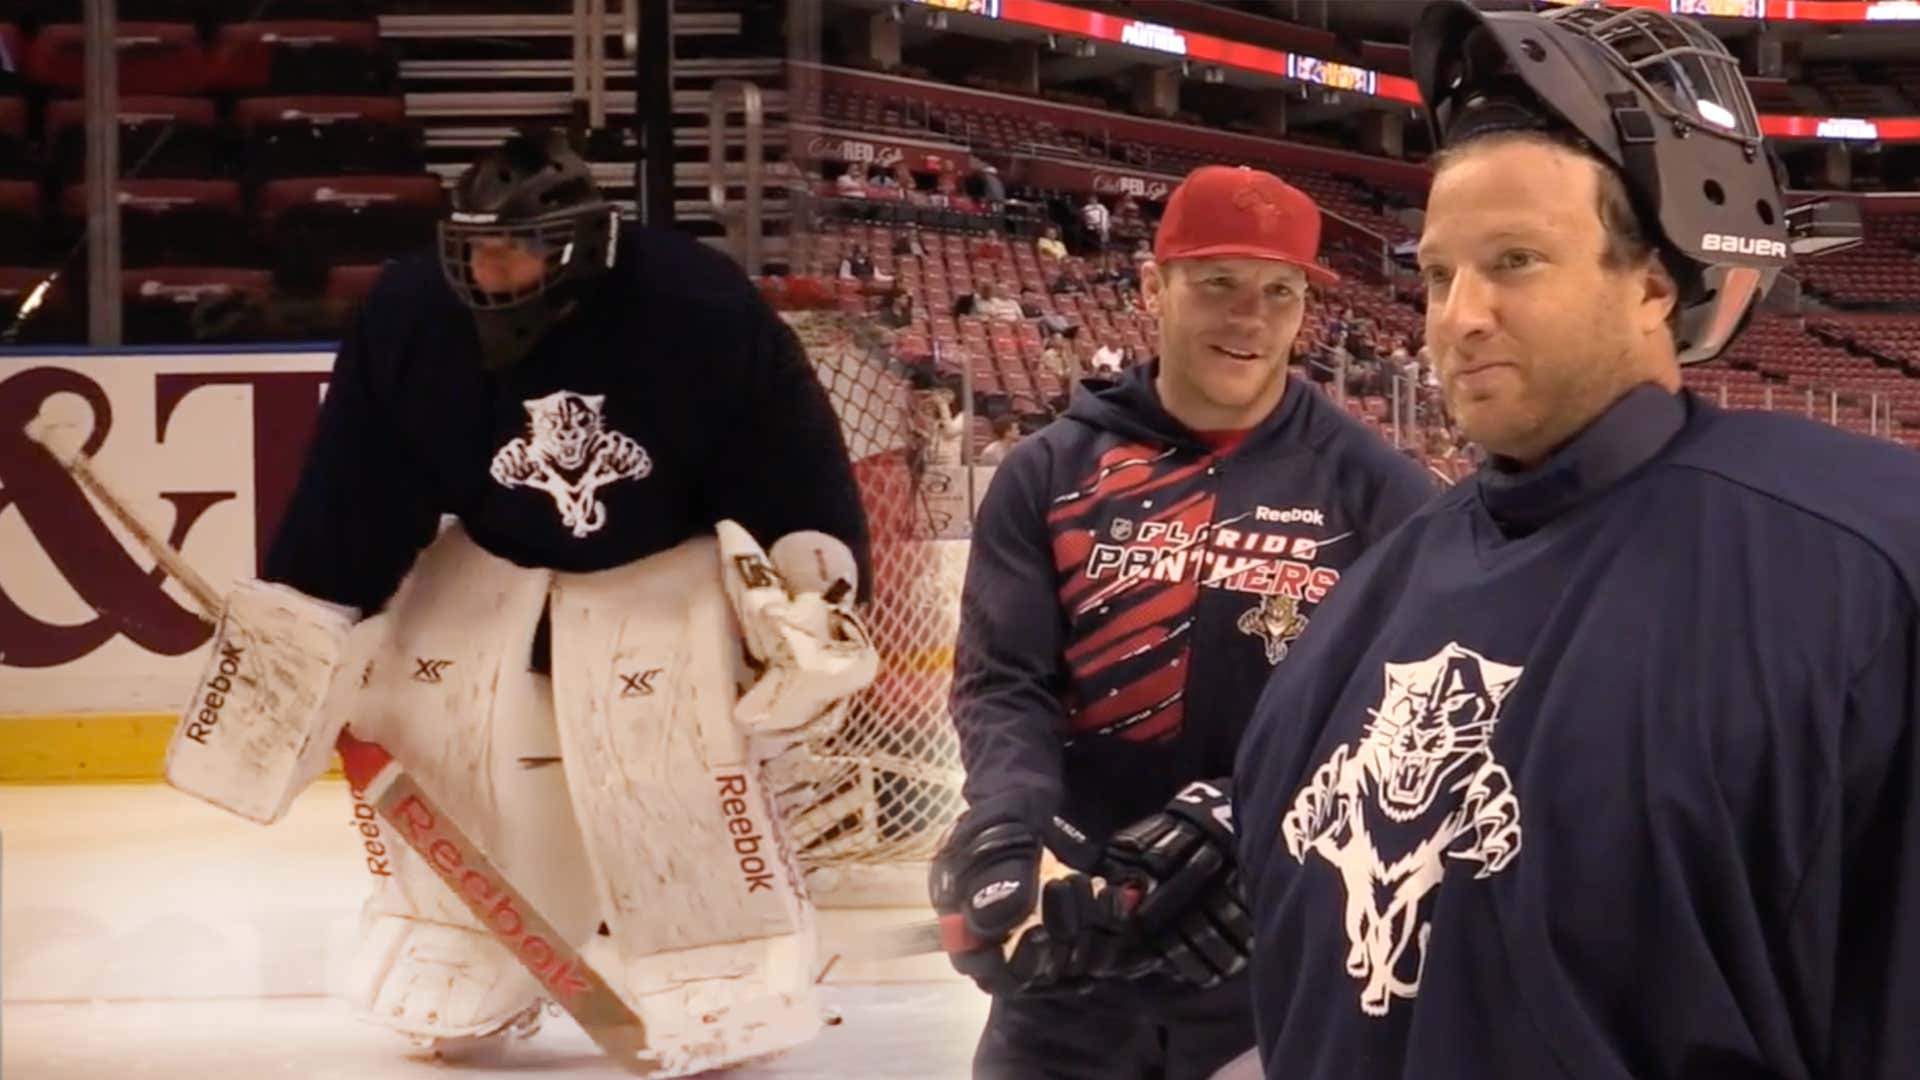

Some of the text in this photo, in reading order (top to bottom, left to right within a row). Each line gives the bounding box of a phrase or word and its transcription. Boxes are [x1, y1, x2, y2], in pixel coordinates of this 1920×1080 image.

[1701, 233, 1787, 259] BAUER
[1255, 505, 1324, 526] Reebok
[1086, 543, 1340, 604] PANTHERS
[186, 640, 247, 746] Reebok
[716, 774, 774, 893] Reebok
[388, 794, 590, 995] Reebok
